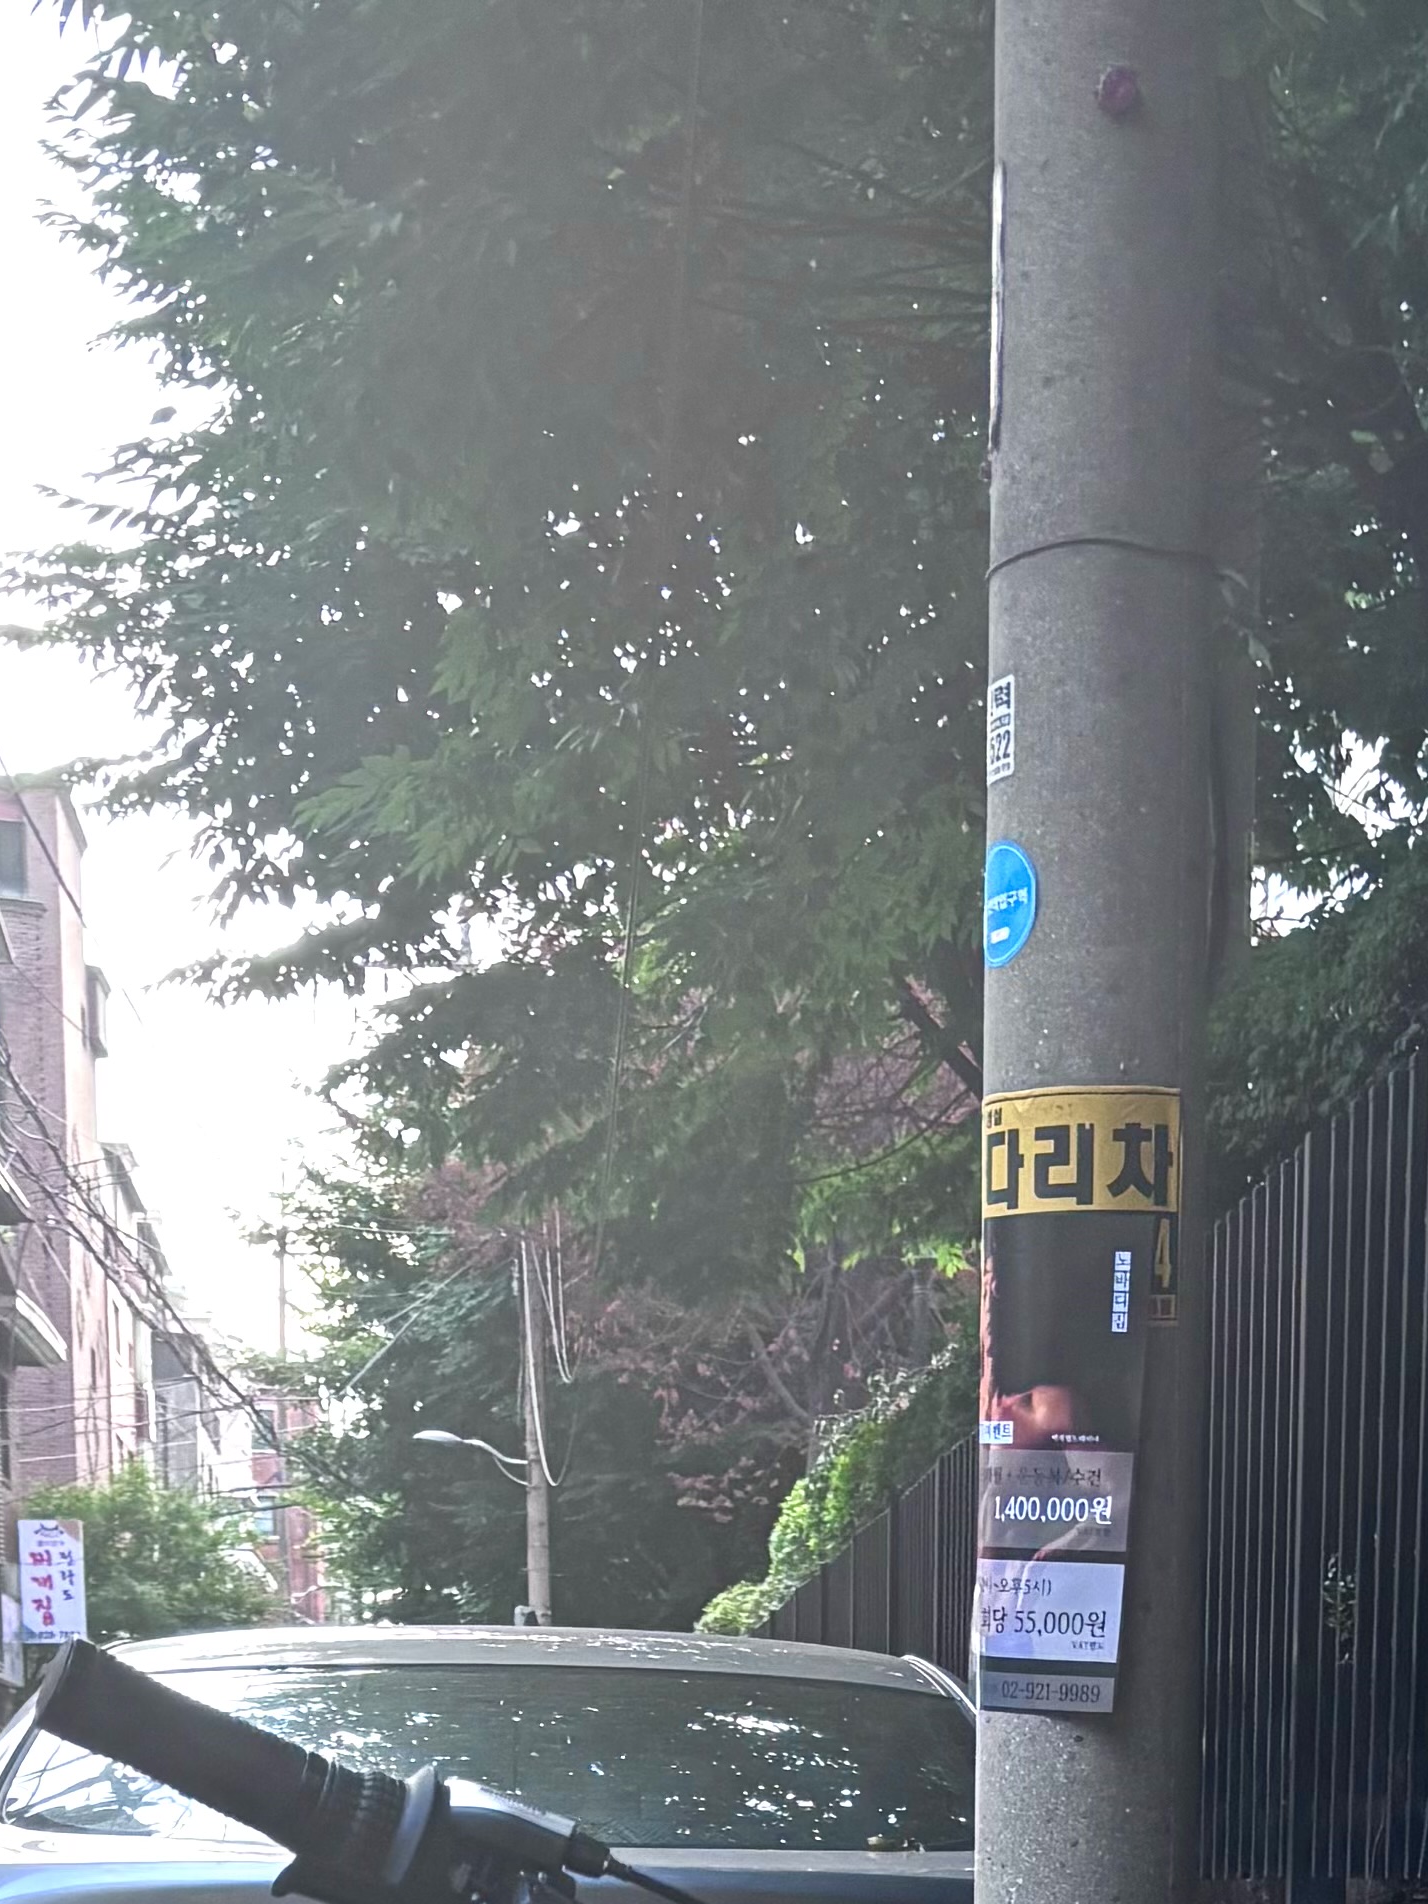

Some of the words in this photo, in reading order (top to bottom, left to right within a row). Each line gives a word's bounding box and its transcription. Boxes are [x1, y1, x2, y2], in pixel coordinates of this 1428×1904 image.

[986, 1122, 1173, 1210] 다리차
[994, 1495, 1113, 1525] 1,400,000원
[1014, 1610, 1107, 1638] 55,000원
[1001, 1680, 1101, 1703] 02-921-9989
